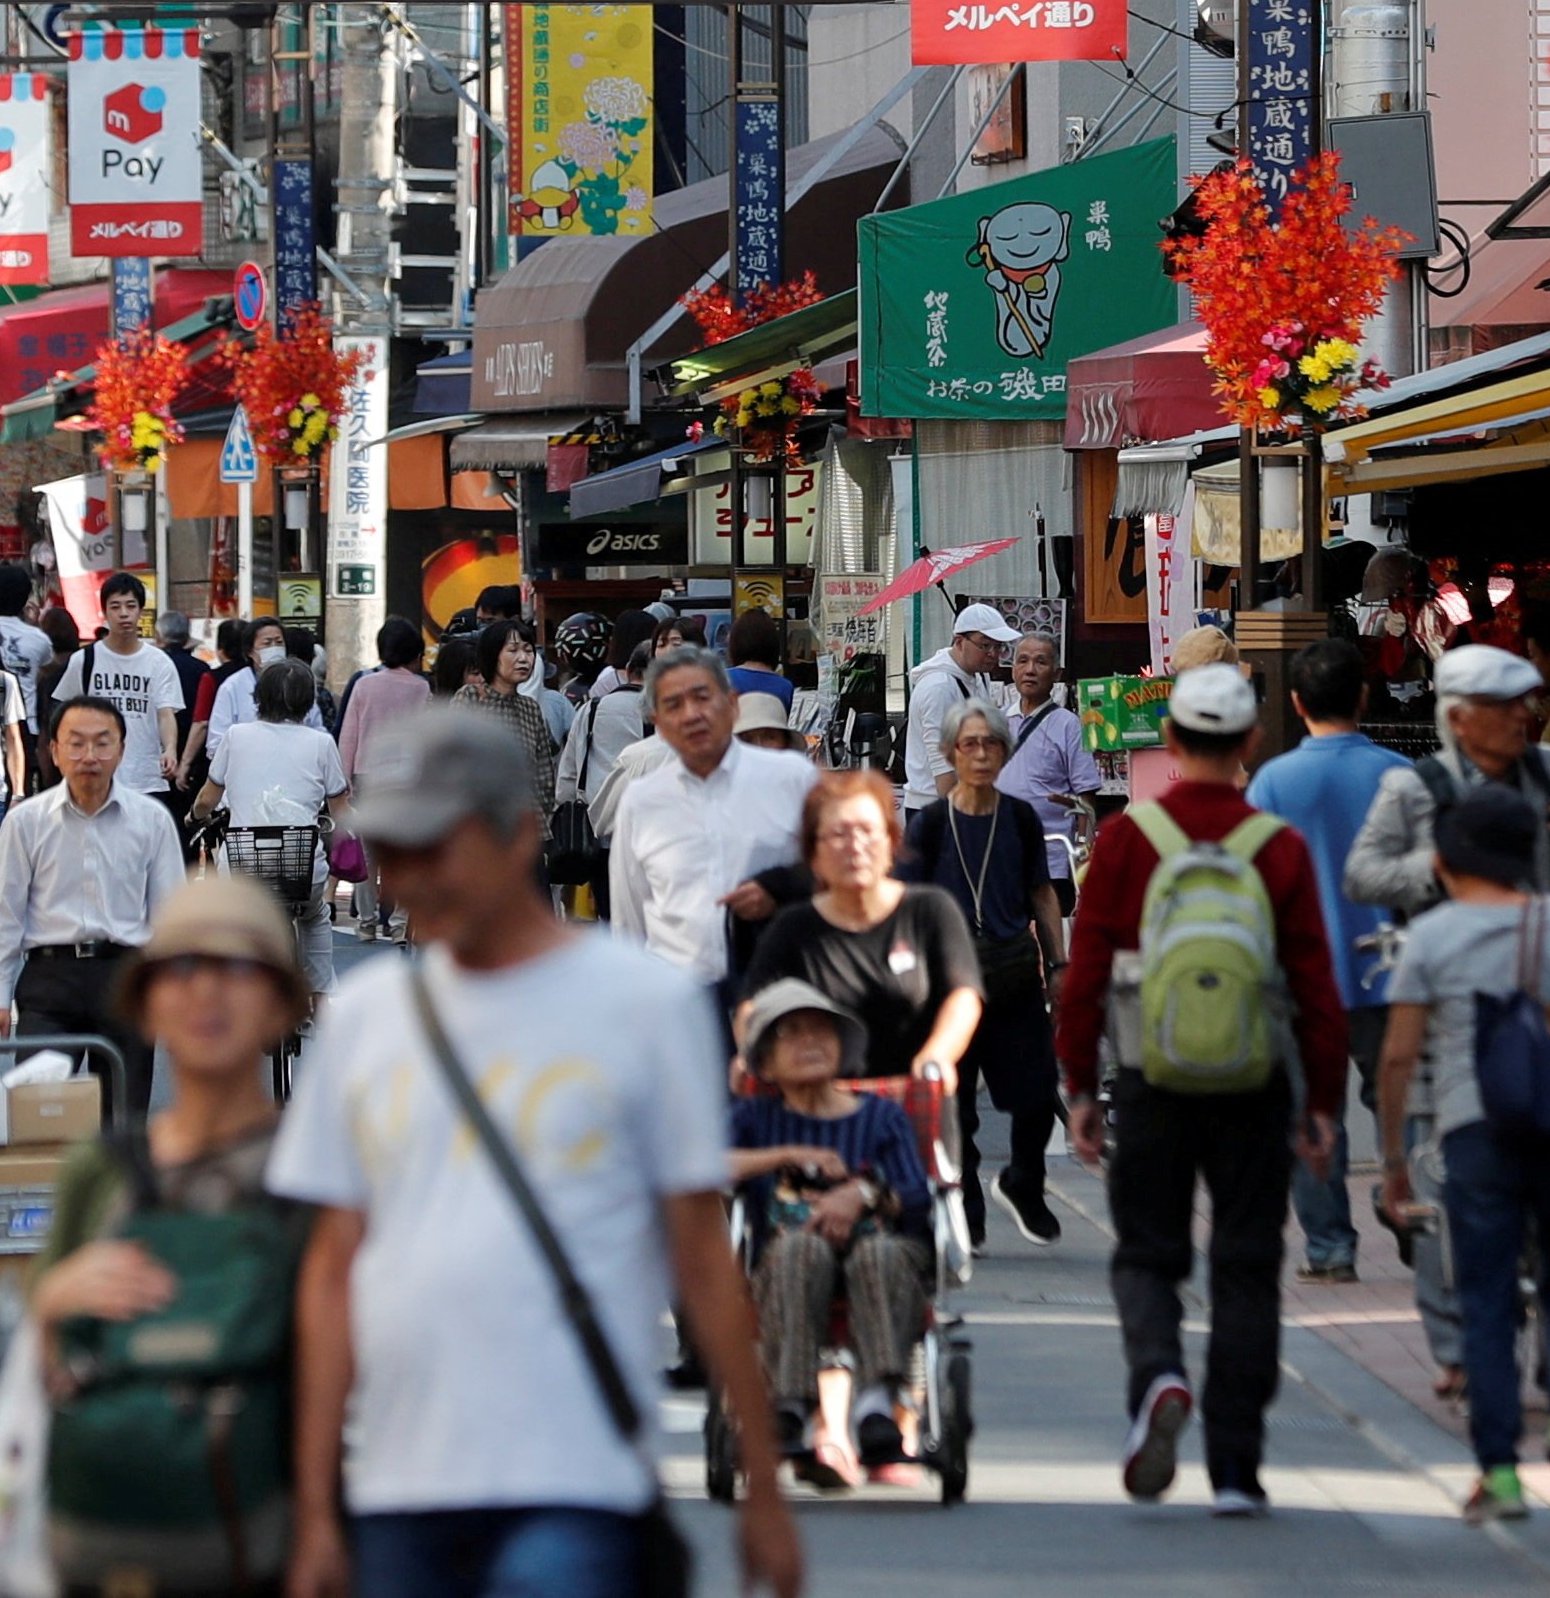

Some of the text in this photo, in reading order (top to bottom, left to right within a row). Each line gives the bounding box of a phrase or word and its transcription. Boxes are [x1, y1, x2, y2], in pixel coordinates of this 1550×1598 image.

[944, 1, 1096, 32] メルペイ通り
[101, 149, 165, 185] Pay
[88, 220, 184, 240] メルペイ通り
[1085, 200, 1112, 252] 巣鴨
[923, 290, 950, 368] 地蔵茶
[346, 390, 372, 516] 佐久間医院
[611, 533, 659, 551] asics
[93, 673, 151, 694] GLADDY
